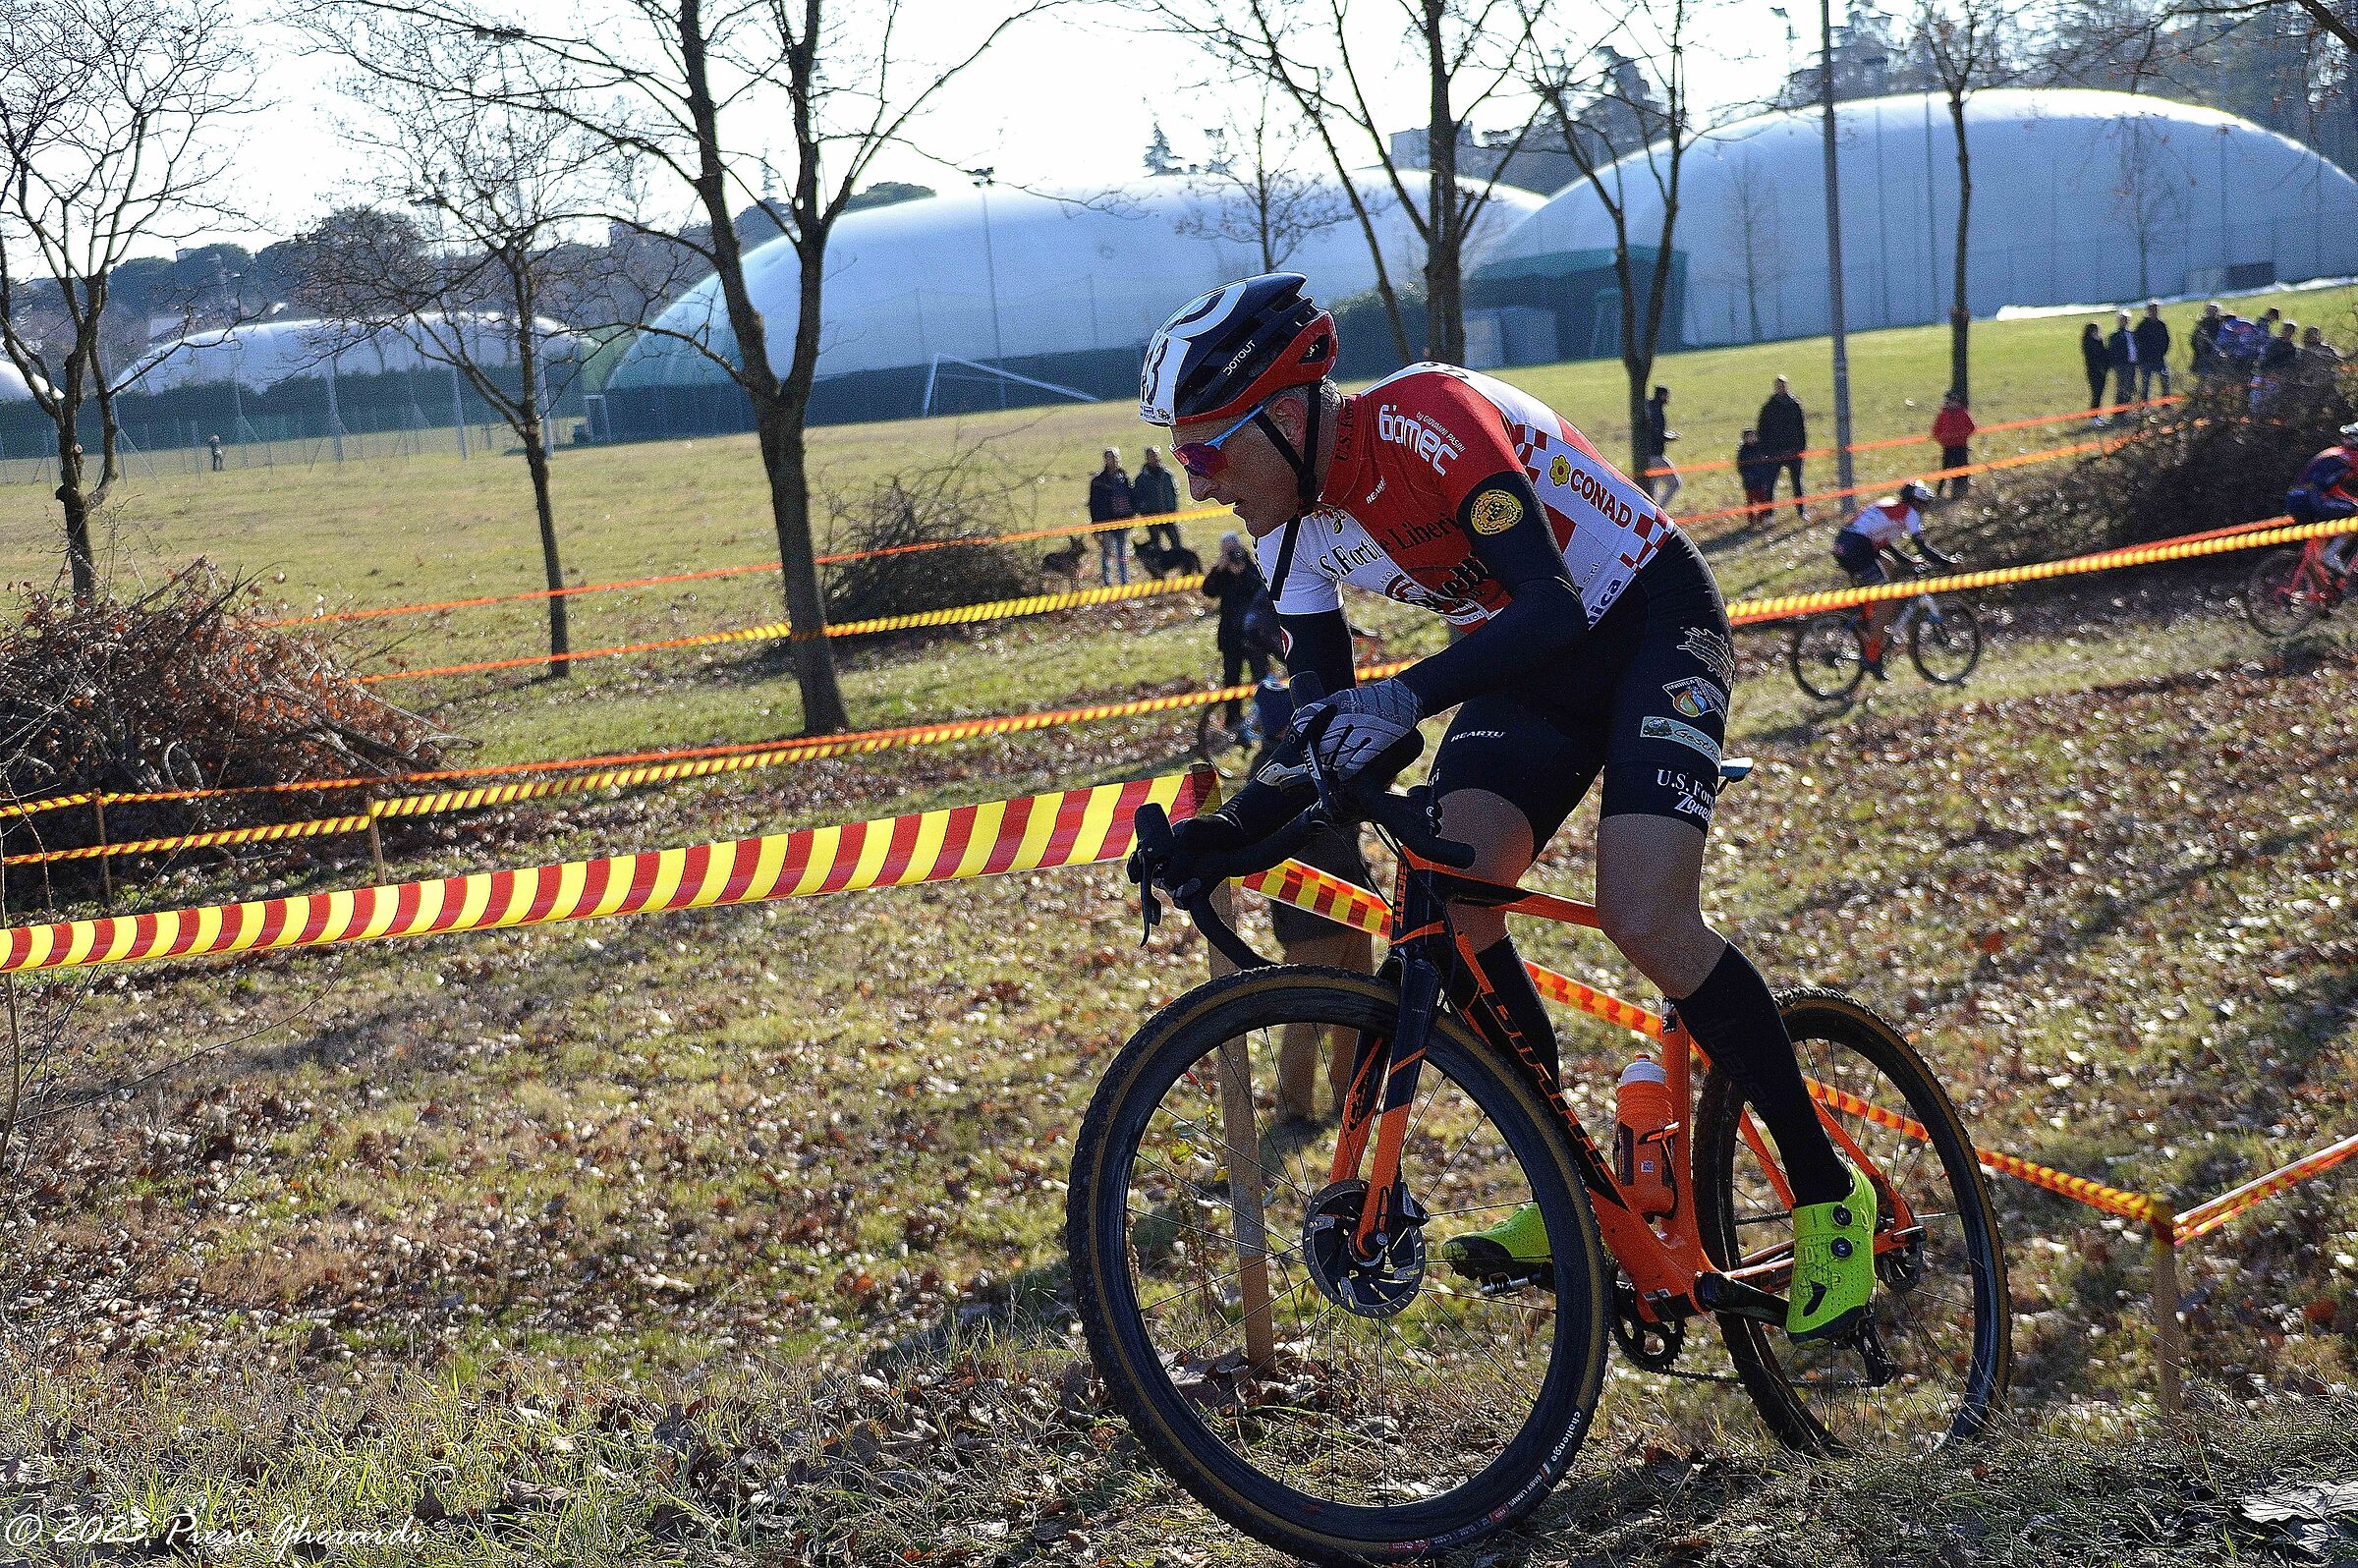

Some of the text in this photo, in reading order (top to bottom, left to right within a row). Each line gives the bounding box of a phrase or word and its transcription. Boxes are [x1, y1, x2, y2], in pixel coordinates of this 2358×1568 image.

[1222, 340, 1257, 376] DOTOUT
[1423, 415, 1449, 436] GIOVANNI
[1446, 433, 1466, 453] PASINI
[1570, 468, 1633, 529] CONAD
[1550, 1411, 1581, 1462] challenge
